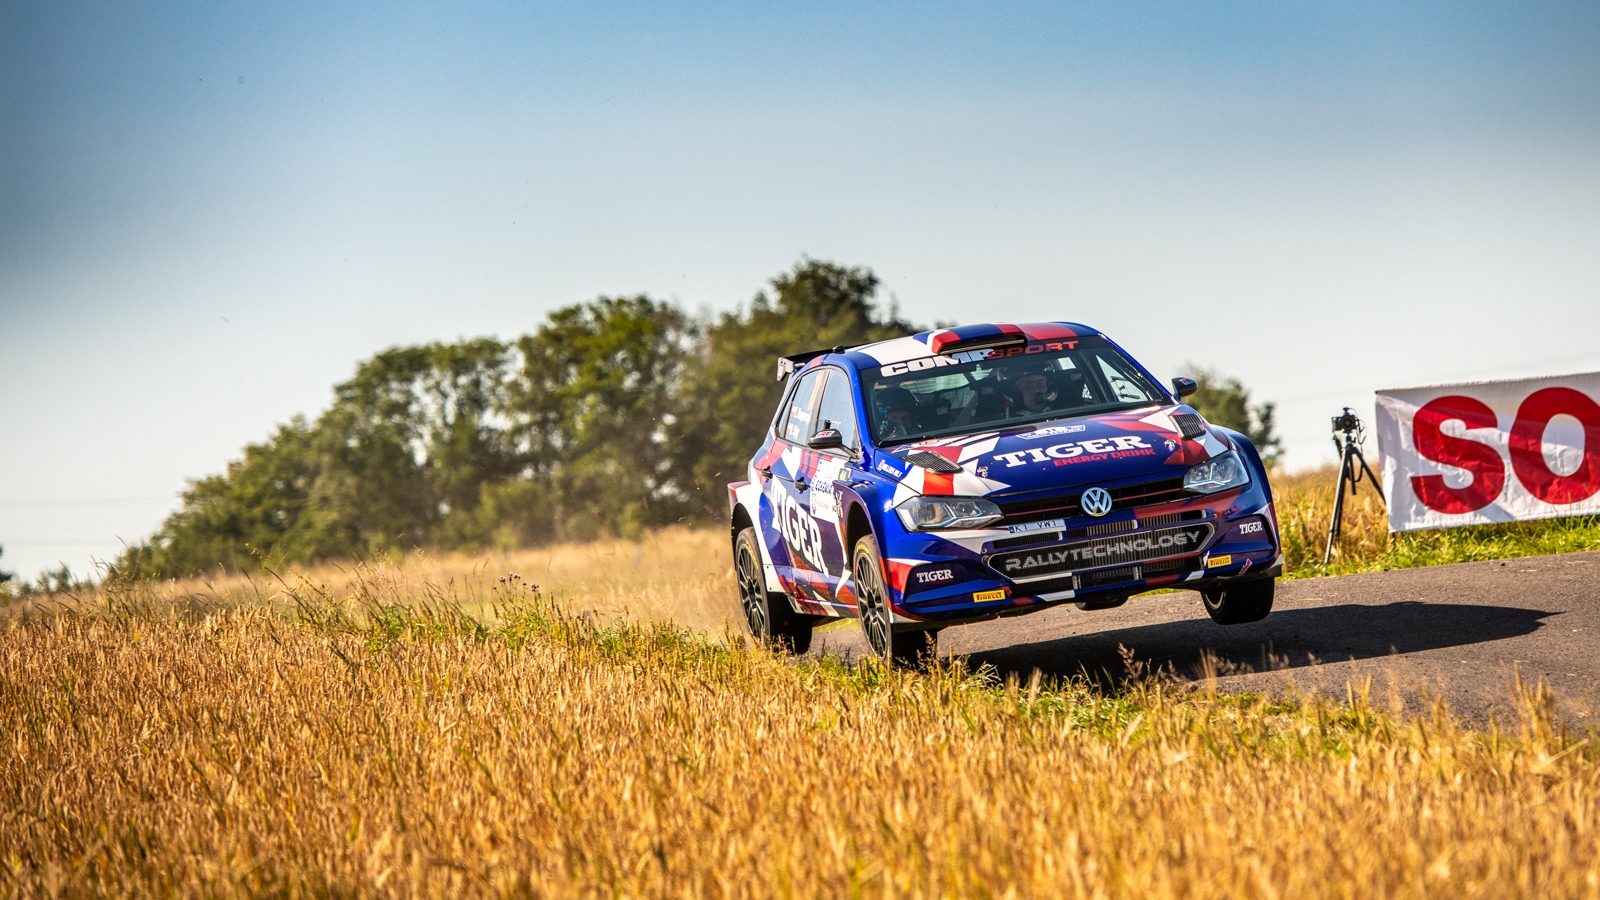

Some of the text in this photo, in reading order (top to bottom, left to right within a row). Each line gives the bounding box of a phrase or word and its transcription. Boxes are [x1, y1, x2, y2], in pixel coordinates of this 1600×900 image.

[993, 436, 1151, 468] TIGER
[1053, 448, 1156, 467] ENERGY DRINK
[1411, 387, 1600, 514] SO
[771, 474, 829, 579] TIGER
[1239, 521, 1263, 535] TIGER
[916, 569, 953, 583] TIGER
